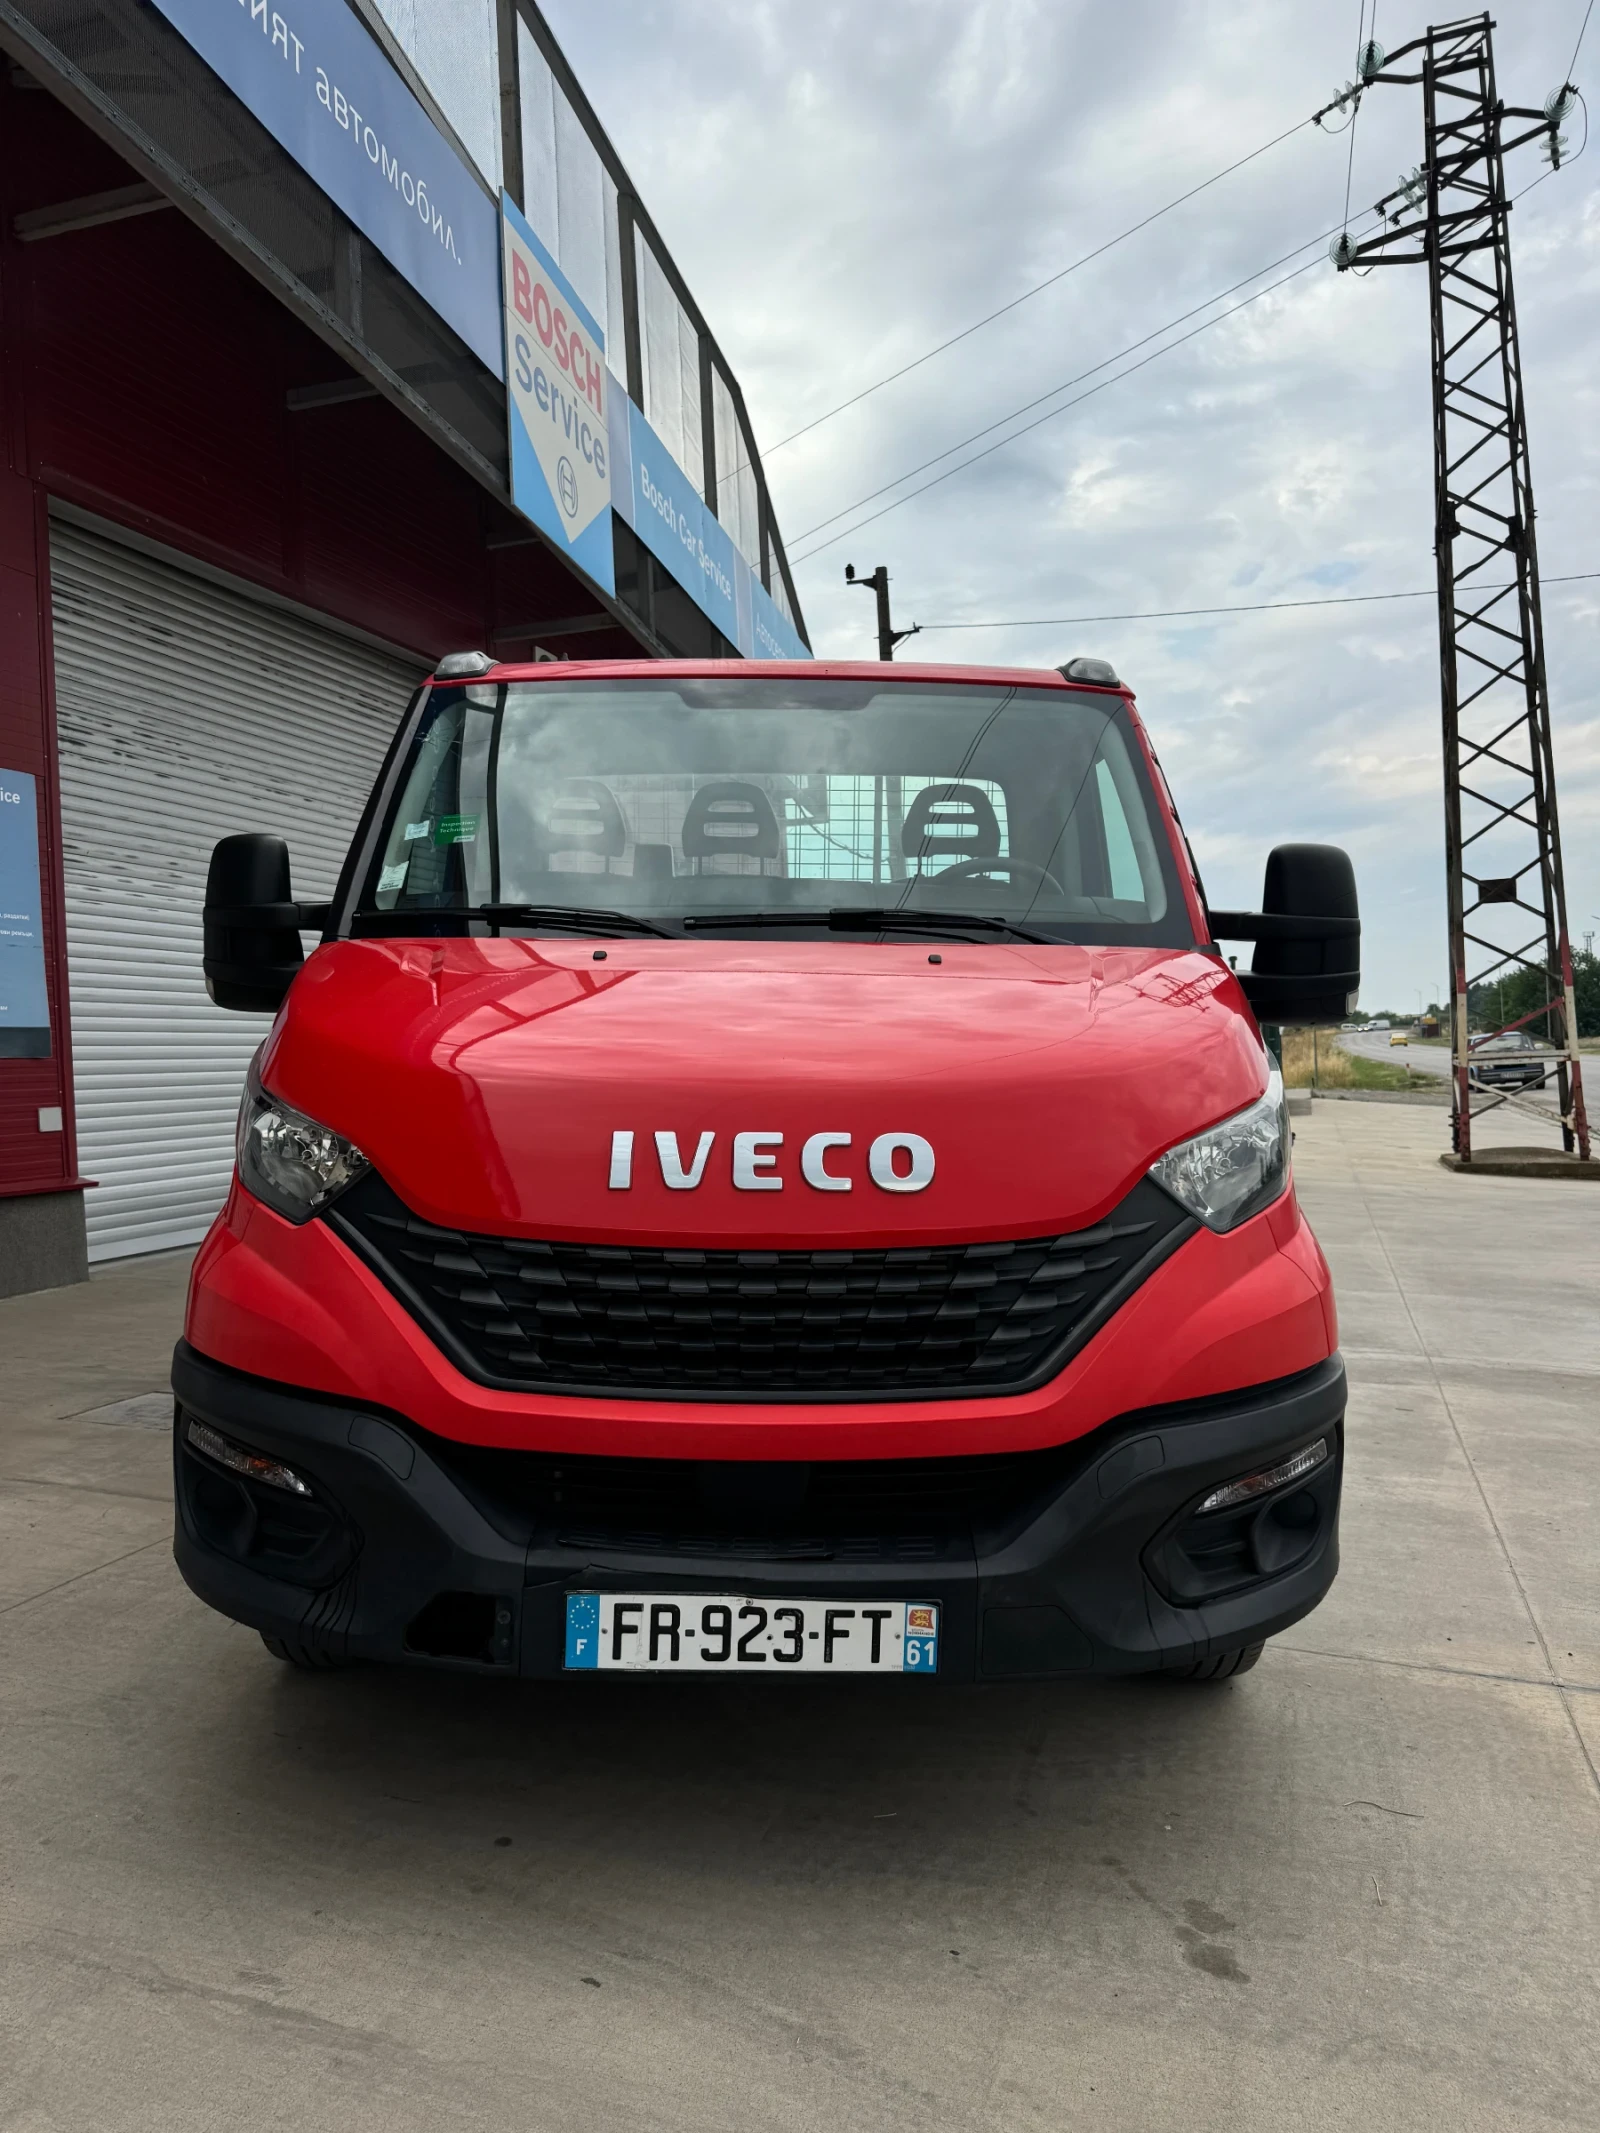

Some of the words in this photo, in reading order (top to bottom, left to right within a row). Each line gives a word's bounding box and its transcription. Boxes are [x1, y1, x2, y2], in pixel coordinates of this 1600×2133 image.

[237, 0, 304, 74] ият
[316, 67, 461, 265] автомобил.
[512, 248, 602, 417] BOSCH
[515, 334, 605, 479] Service
[640, 463, 677, 533] Bosch
[679, 514, 696, 556] Car
[698, 538, 732, 600] Service
[0, 787, 20, 804] ice
[608, 1131, 936, 1192] IVECO
[576, 1639, 586, 1655] F
[612, 1602, 892, 1663] FR-923-FT
[906, 1640, 935, 1666] 61
